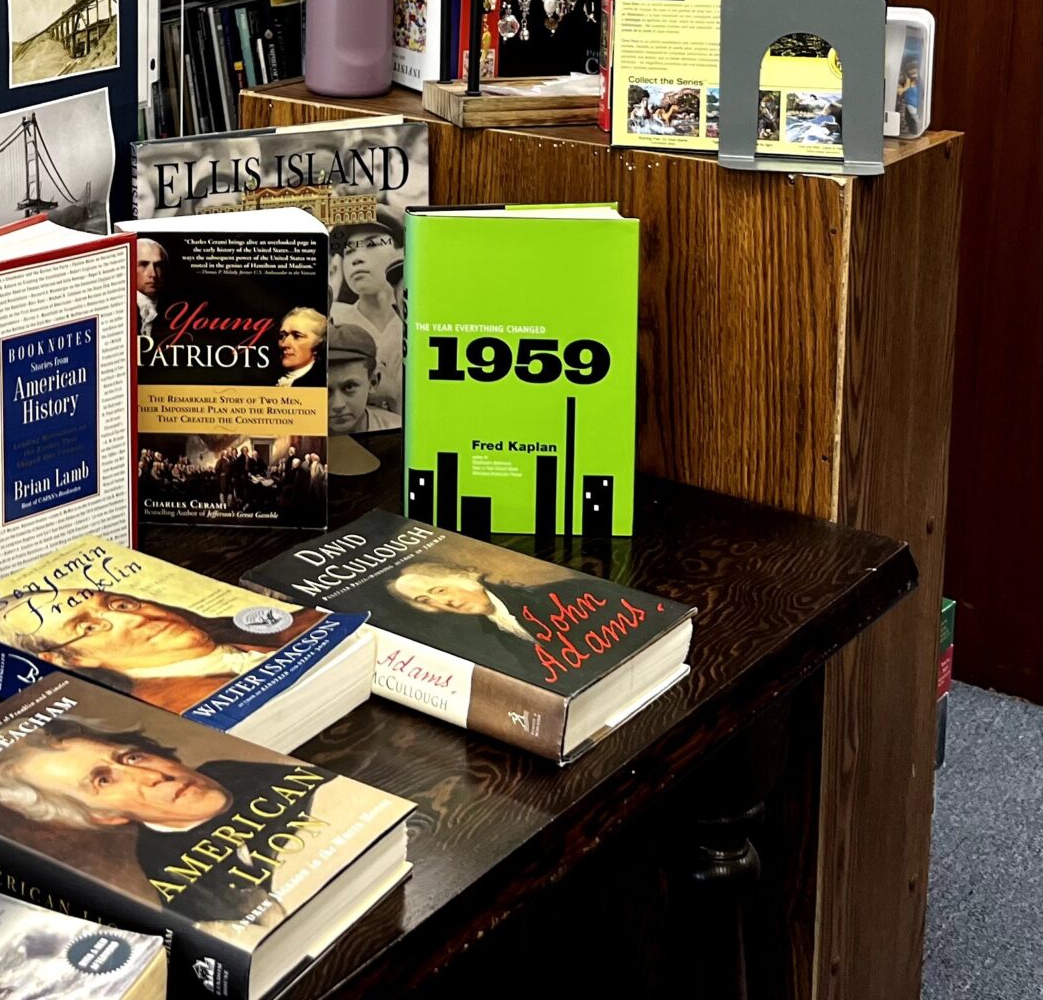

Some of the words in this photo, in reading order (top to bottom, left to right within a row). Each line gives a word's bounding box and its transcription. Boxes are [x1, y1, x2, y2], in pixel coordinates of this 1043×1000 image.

[628, 75, 662, 86] Collect
[664, 76, 676, 86] the
[154, 157, 261, 210] ELLIS
[275, 145, 410, 192] ISLAND
[163, 301, 275, 349] Young
[415, 322, 430, 332] THE
[432, 323, 453, 332] YEAR
[455, 324, 504, 333] EVERYTHING
[506, 325, 546, 334] CHANGED
[8, 329, 93, 364] BOOKNOTES
[30, 359, 53, 372] Stories
[54, 356, 69, 367] from
[137, 335, 270, 368] PATRIOTS
[428, 336, 611, 385] 1959
[13, 366, 87, 401] American
[22, 394, 79, 424] History
[472, 440, 503, 451] Fred
[508, 441, 557, 454] Kaplan
[14, 478, 50, 500] Brian
[55, 461, 89, 488] Lamb
[144, 500, 187, 509] CHARLES
[190, 500, 227, 510] CERAMI
[294, 533, 367, 568] DAVID
[523, 591, 607, 642] John
[193, 673, 266, 718] WALTER
[266, 619, 340, 677] ISAACSON
[149, 766, 326, 902] AMERICAN
[237, 812, 333, 888] LION
